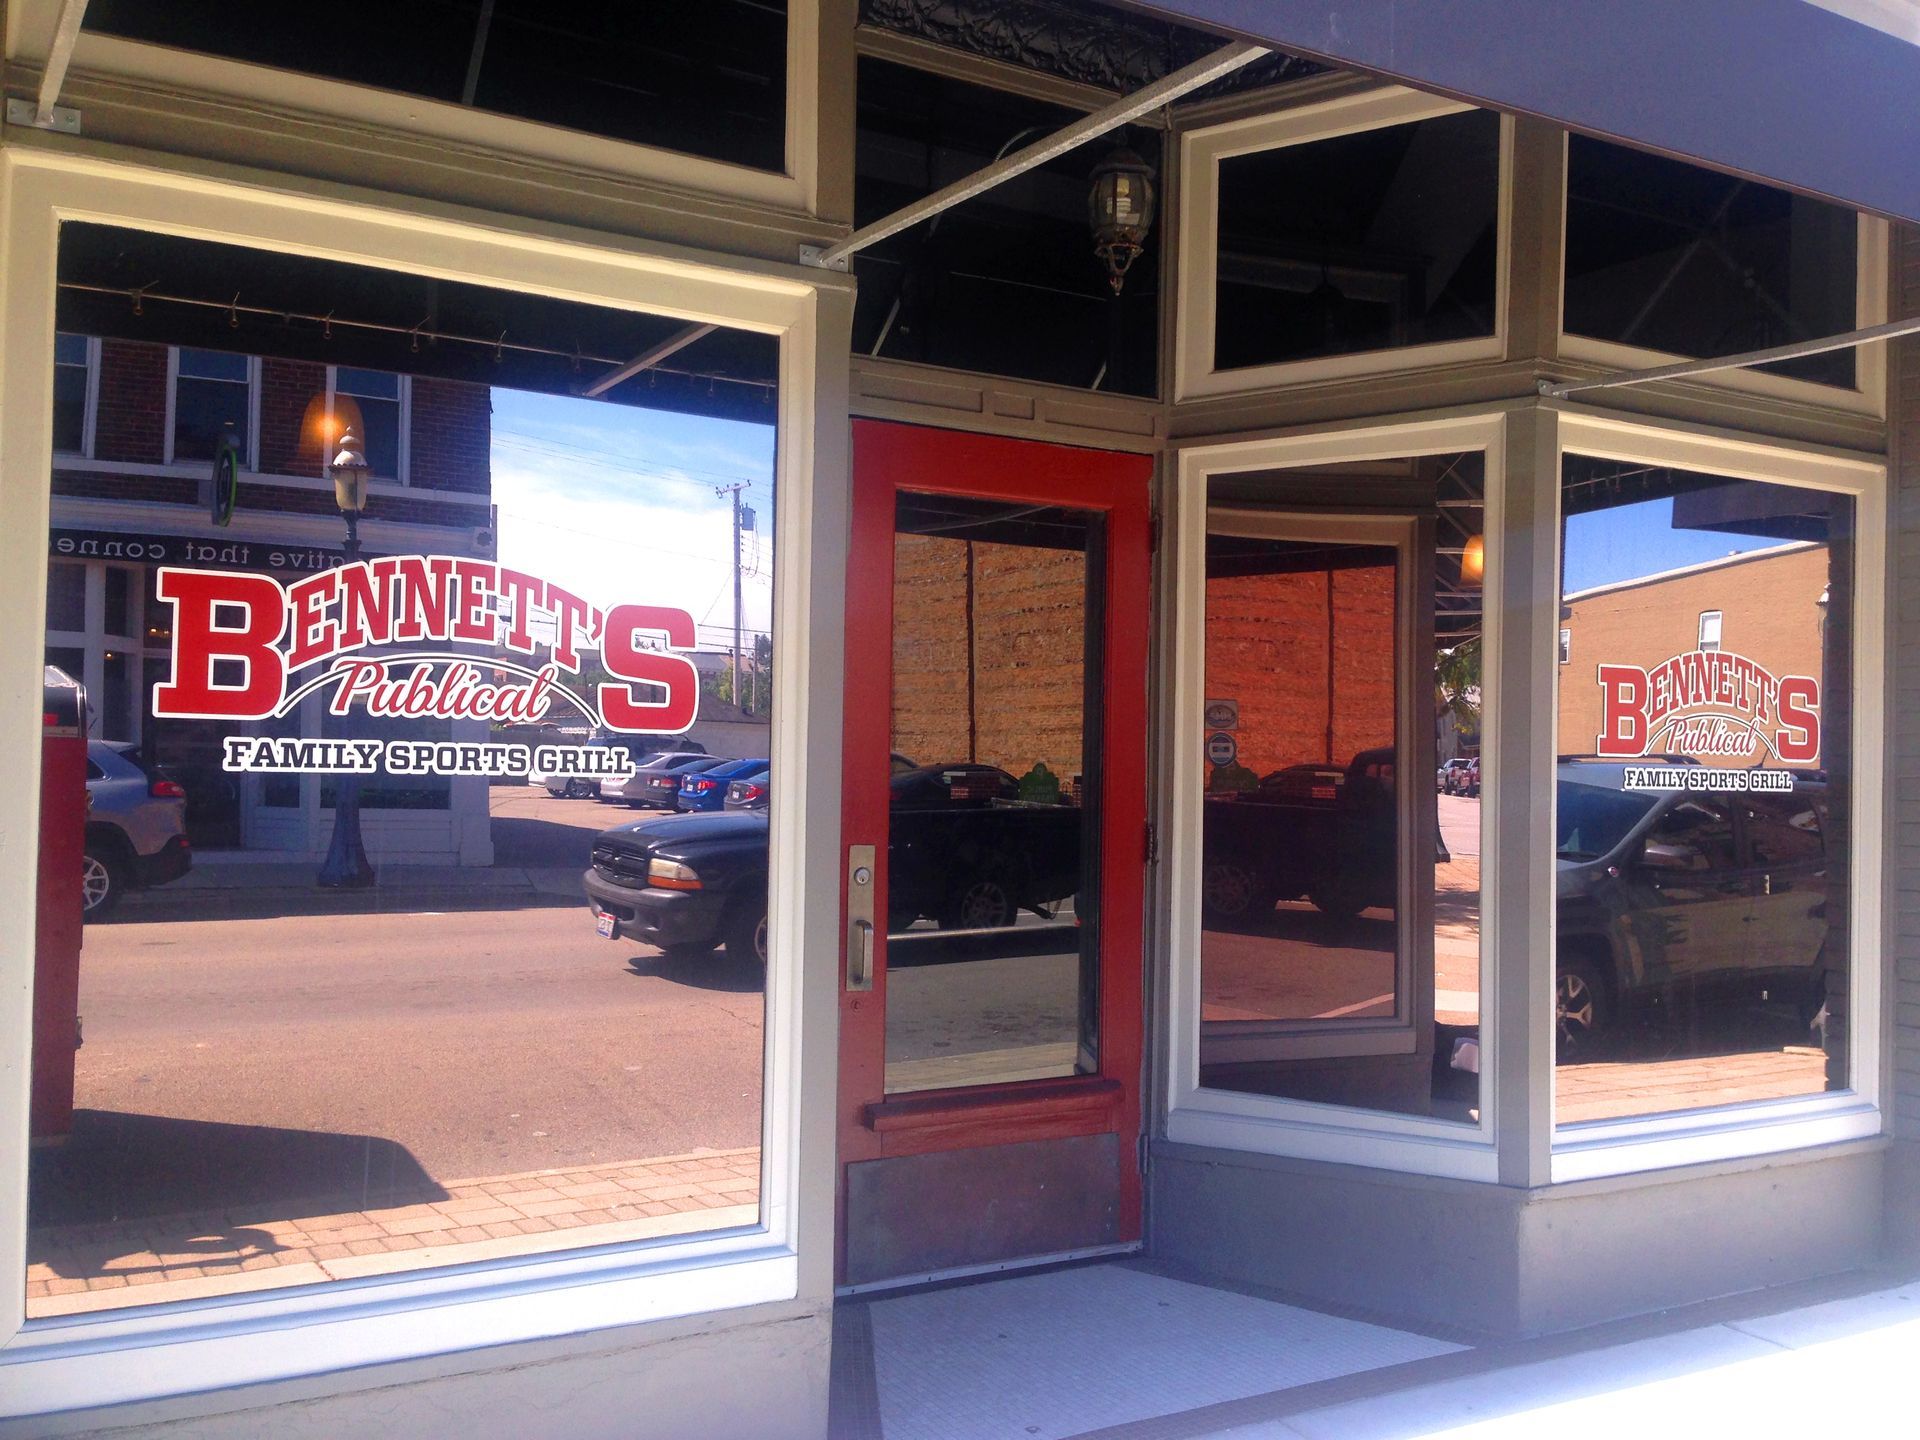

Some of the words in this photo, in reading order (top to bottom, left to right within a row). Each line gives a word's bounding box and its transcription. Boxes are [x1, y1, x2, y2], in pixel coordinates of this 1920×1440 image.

[154, 555, 699, 735] BENNETT'S
[331, 660, 556, 722] Publical
[1597, 650, 1820, 763] BENNETT'S
[225, 739, 382, 773] FAMILY
[386, 741, 529, 776] SPORTS
[532, 744, 634, 778] GRILL
[1667, 717, 1759, 756] Publical
[1625, 768, 1687, 790] FAMILY
[1688, 769, 1747, 791] SPORTS
[1750, 771, 1793, 793] GRILL
